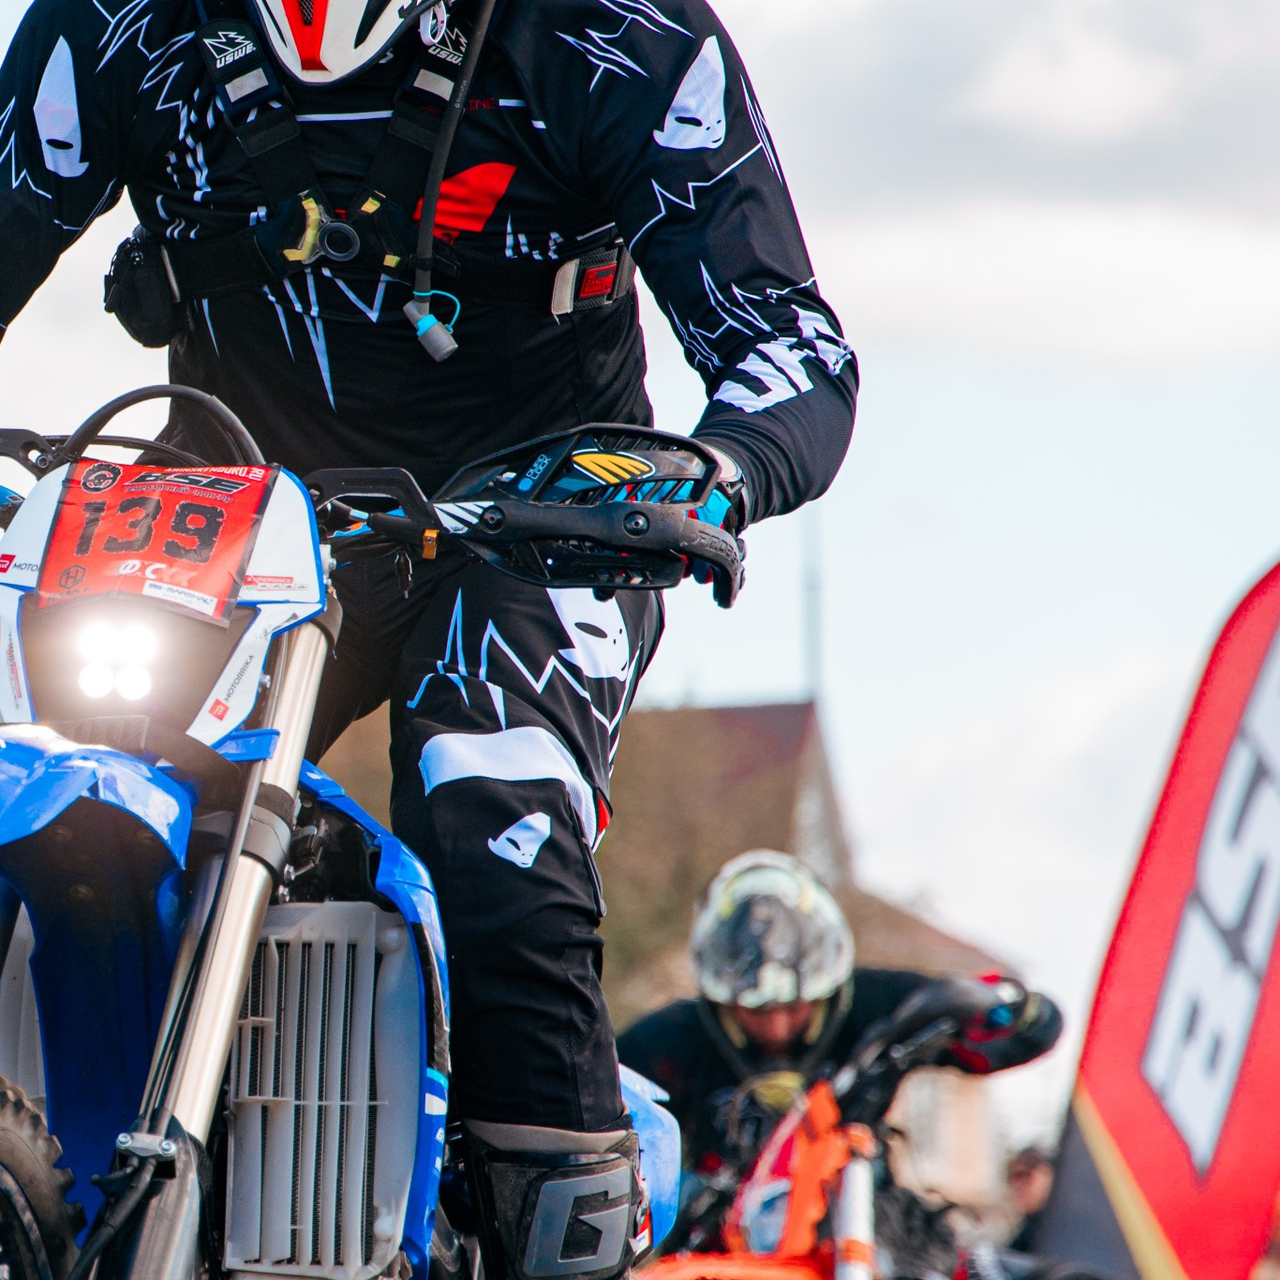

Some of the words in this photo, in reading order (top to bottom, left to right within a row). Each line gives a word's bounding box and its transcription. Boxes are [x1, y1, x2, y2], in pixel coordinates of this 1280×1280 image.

[216, 42, 253, 69] USWE
[427, 44, 462, 66] USW
[74, 496, 226, 564] 139
[12, 562, 40, 572] MOTO
[224, 655, 255, 703] MOTORRIKA
[1141, 616, 1280, 1173] BS
